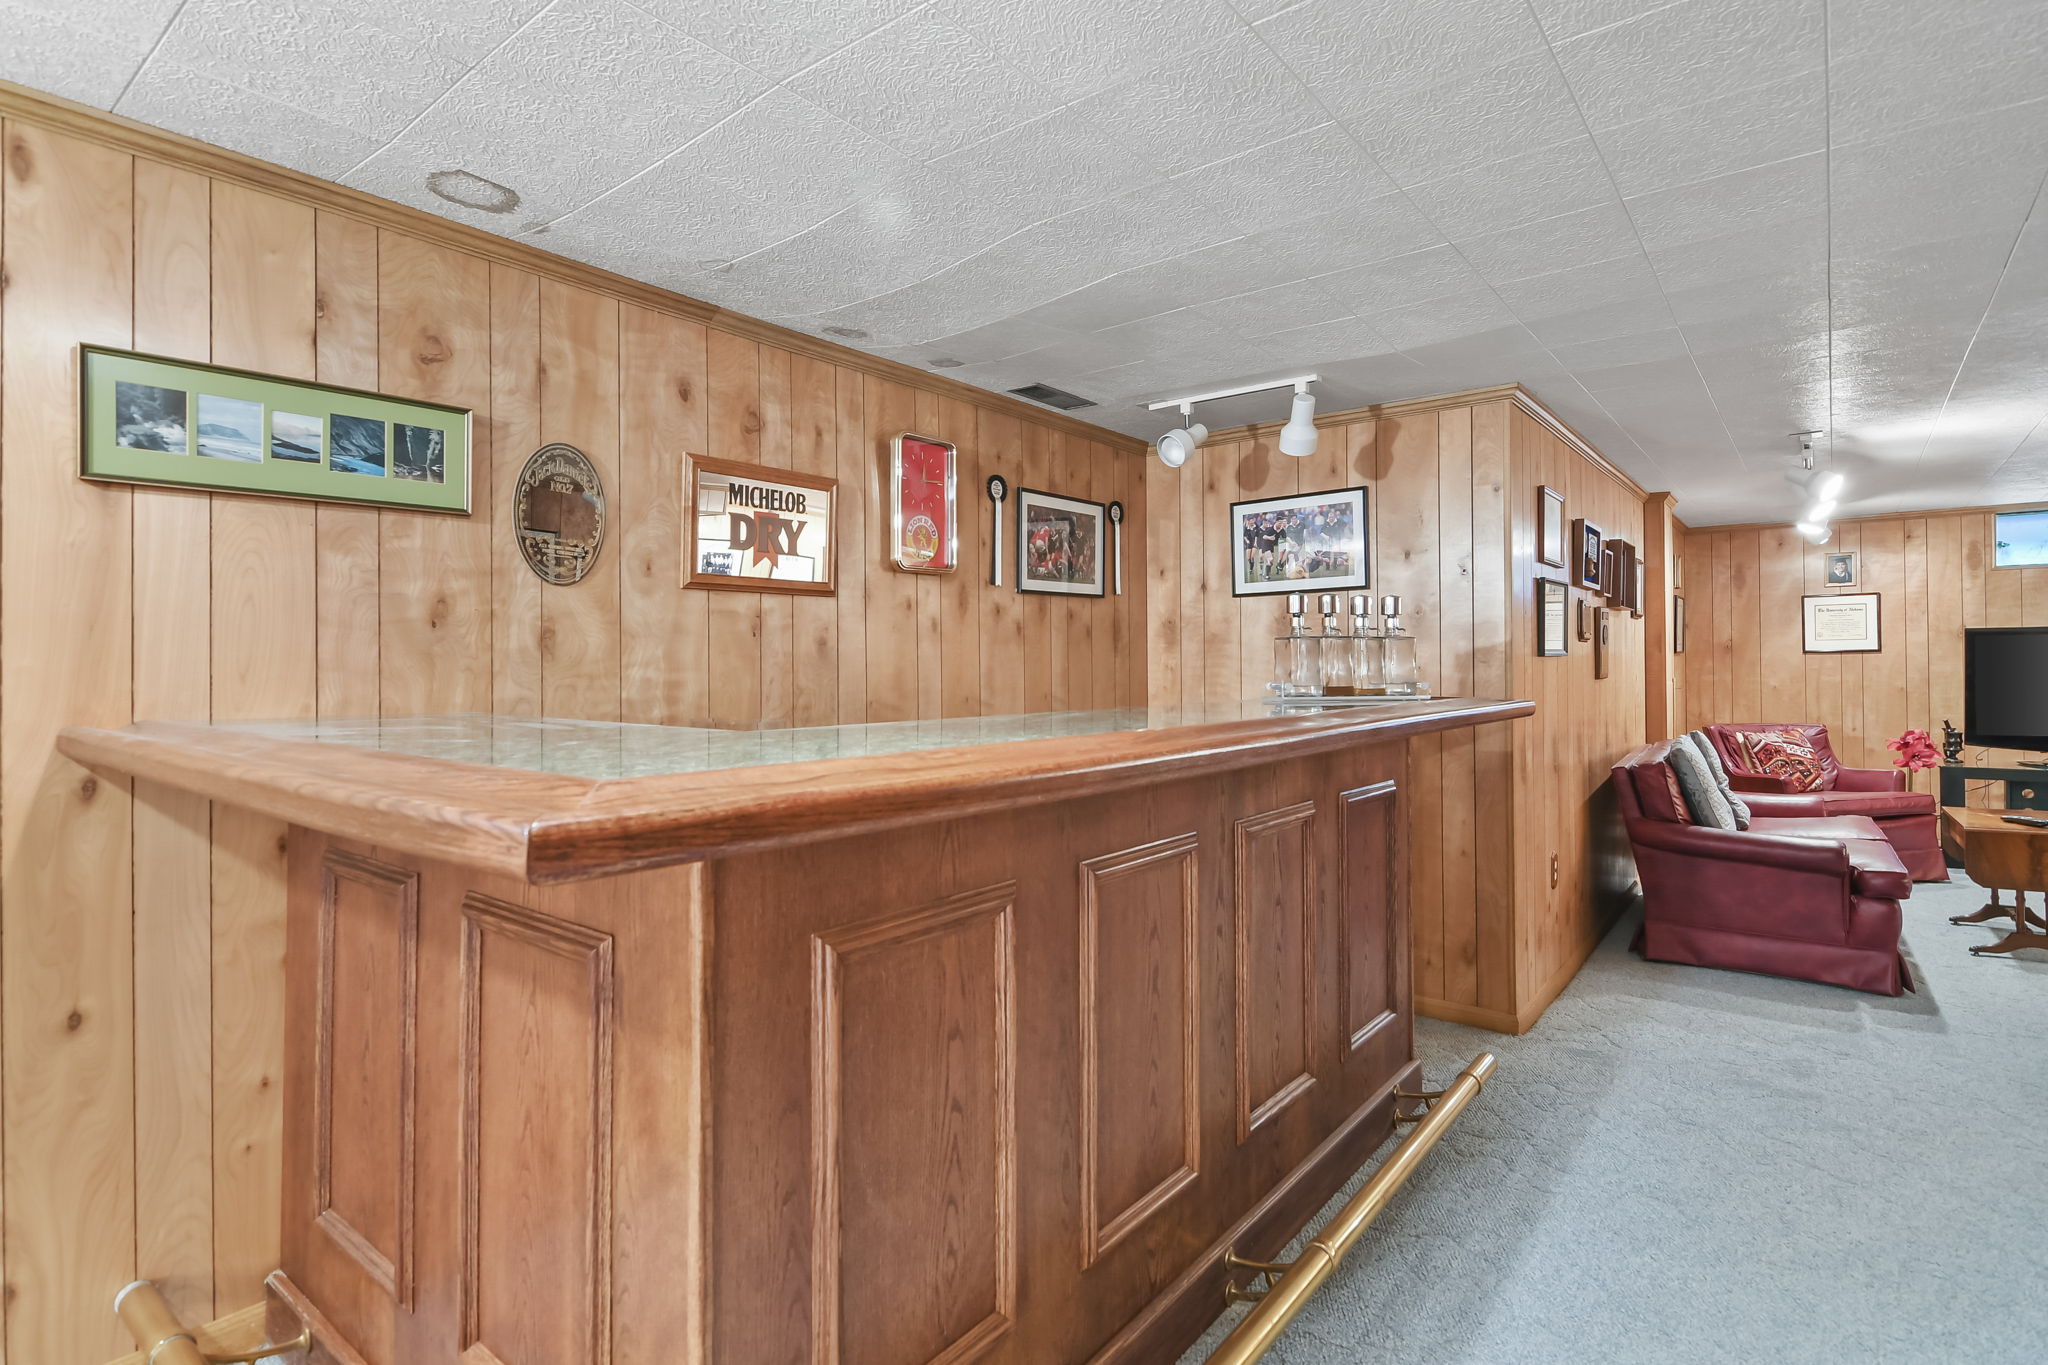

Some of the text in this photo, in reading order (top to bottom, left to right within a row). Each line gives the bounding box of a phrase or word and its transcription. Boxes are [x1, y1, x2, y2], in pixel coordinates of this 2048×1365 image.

[728, 482, 807, 514] MICHELOB
[728, 511, 808, 556] DRY
[907, 517, 937, 537] LION RED
